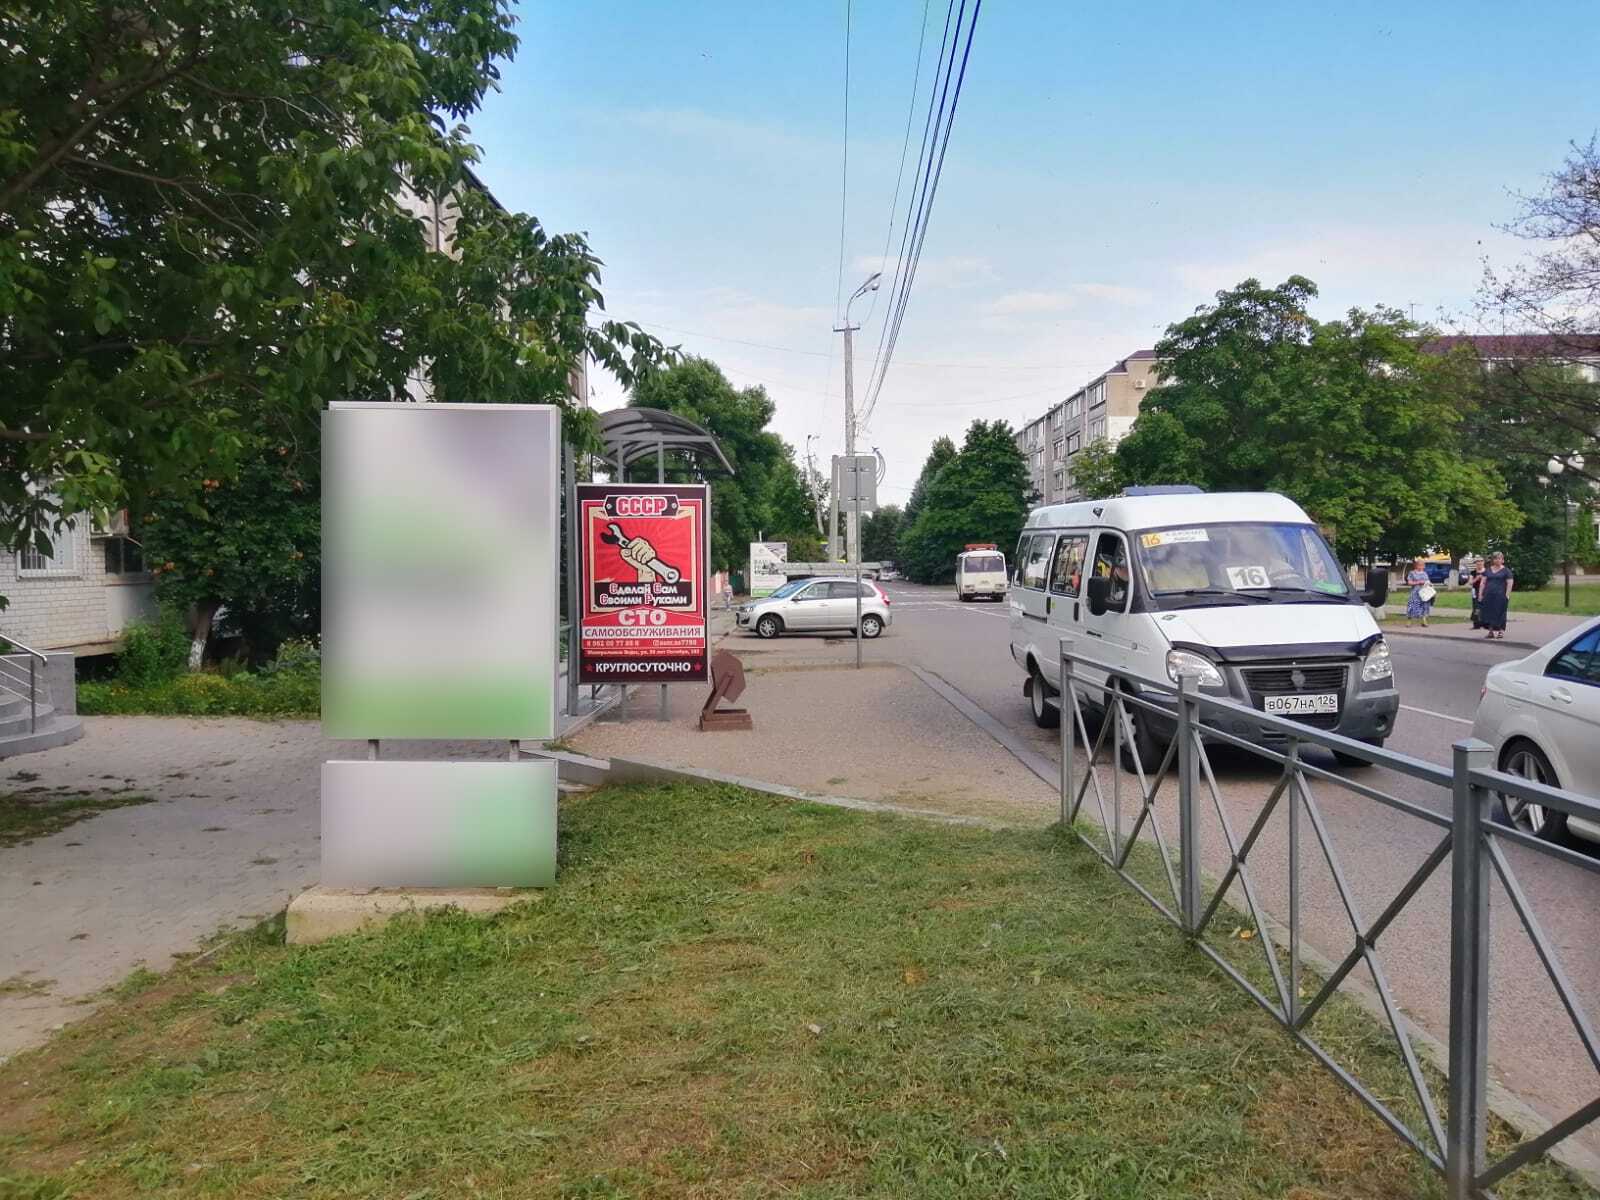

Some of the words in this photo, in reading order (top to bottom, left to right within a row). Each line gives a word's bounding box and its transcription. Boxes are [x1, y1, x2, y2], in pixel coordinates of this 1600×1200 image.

[616, 497, 667, 515] СССР
[1144, 535, 1161, 546] 16
[1234, 568, 1265, 586] 16
[609, 583, 651, 595] Сделай
[653, 583, 678, 594] Сам
[600, 594, 642, 605] Своими
[644, 594, 687, 606] Руками
[618, 609, 667, 625] СТО
[584, 628, 700, 637] САМООБСЛУЖИВАНИЯ
[595, 662, 691, 673] КРУГЛОСУТОЧНО
[1268, 697, 1315, 710] В067НА
[1317, 695, 1336, 705] 126
